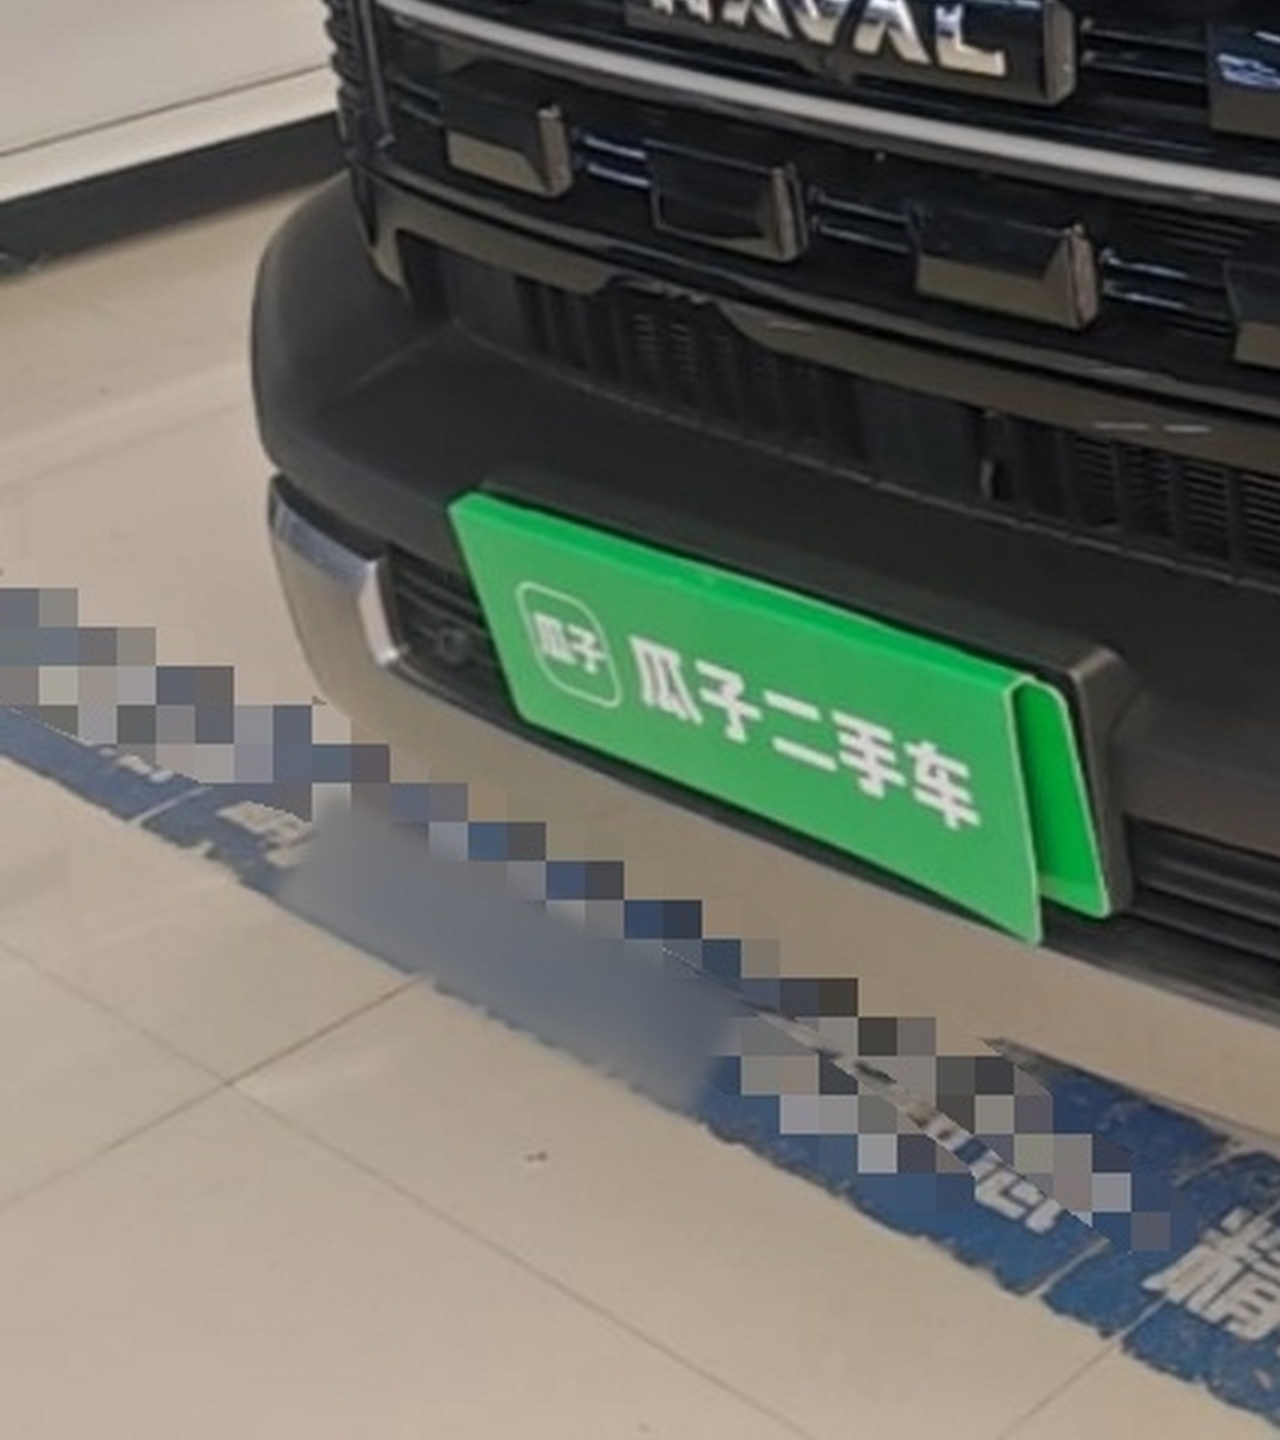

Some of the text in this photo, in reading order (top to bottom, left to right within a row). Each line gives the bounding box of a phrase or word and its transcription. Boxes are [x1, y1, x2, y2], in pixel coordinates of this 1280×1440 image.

[533, 612, 606, 674] 瓜子
[628, 635, 980, 830] 瓜子二手车
